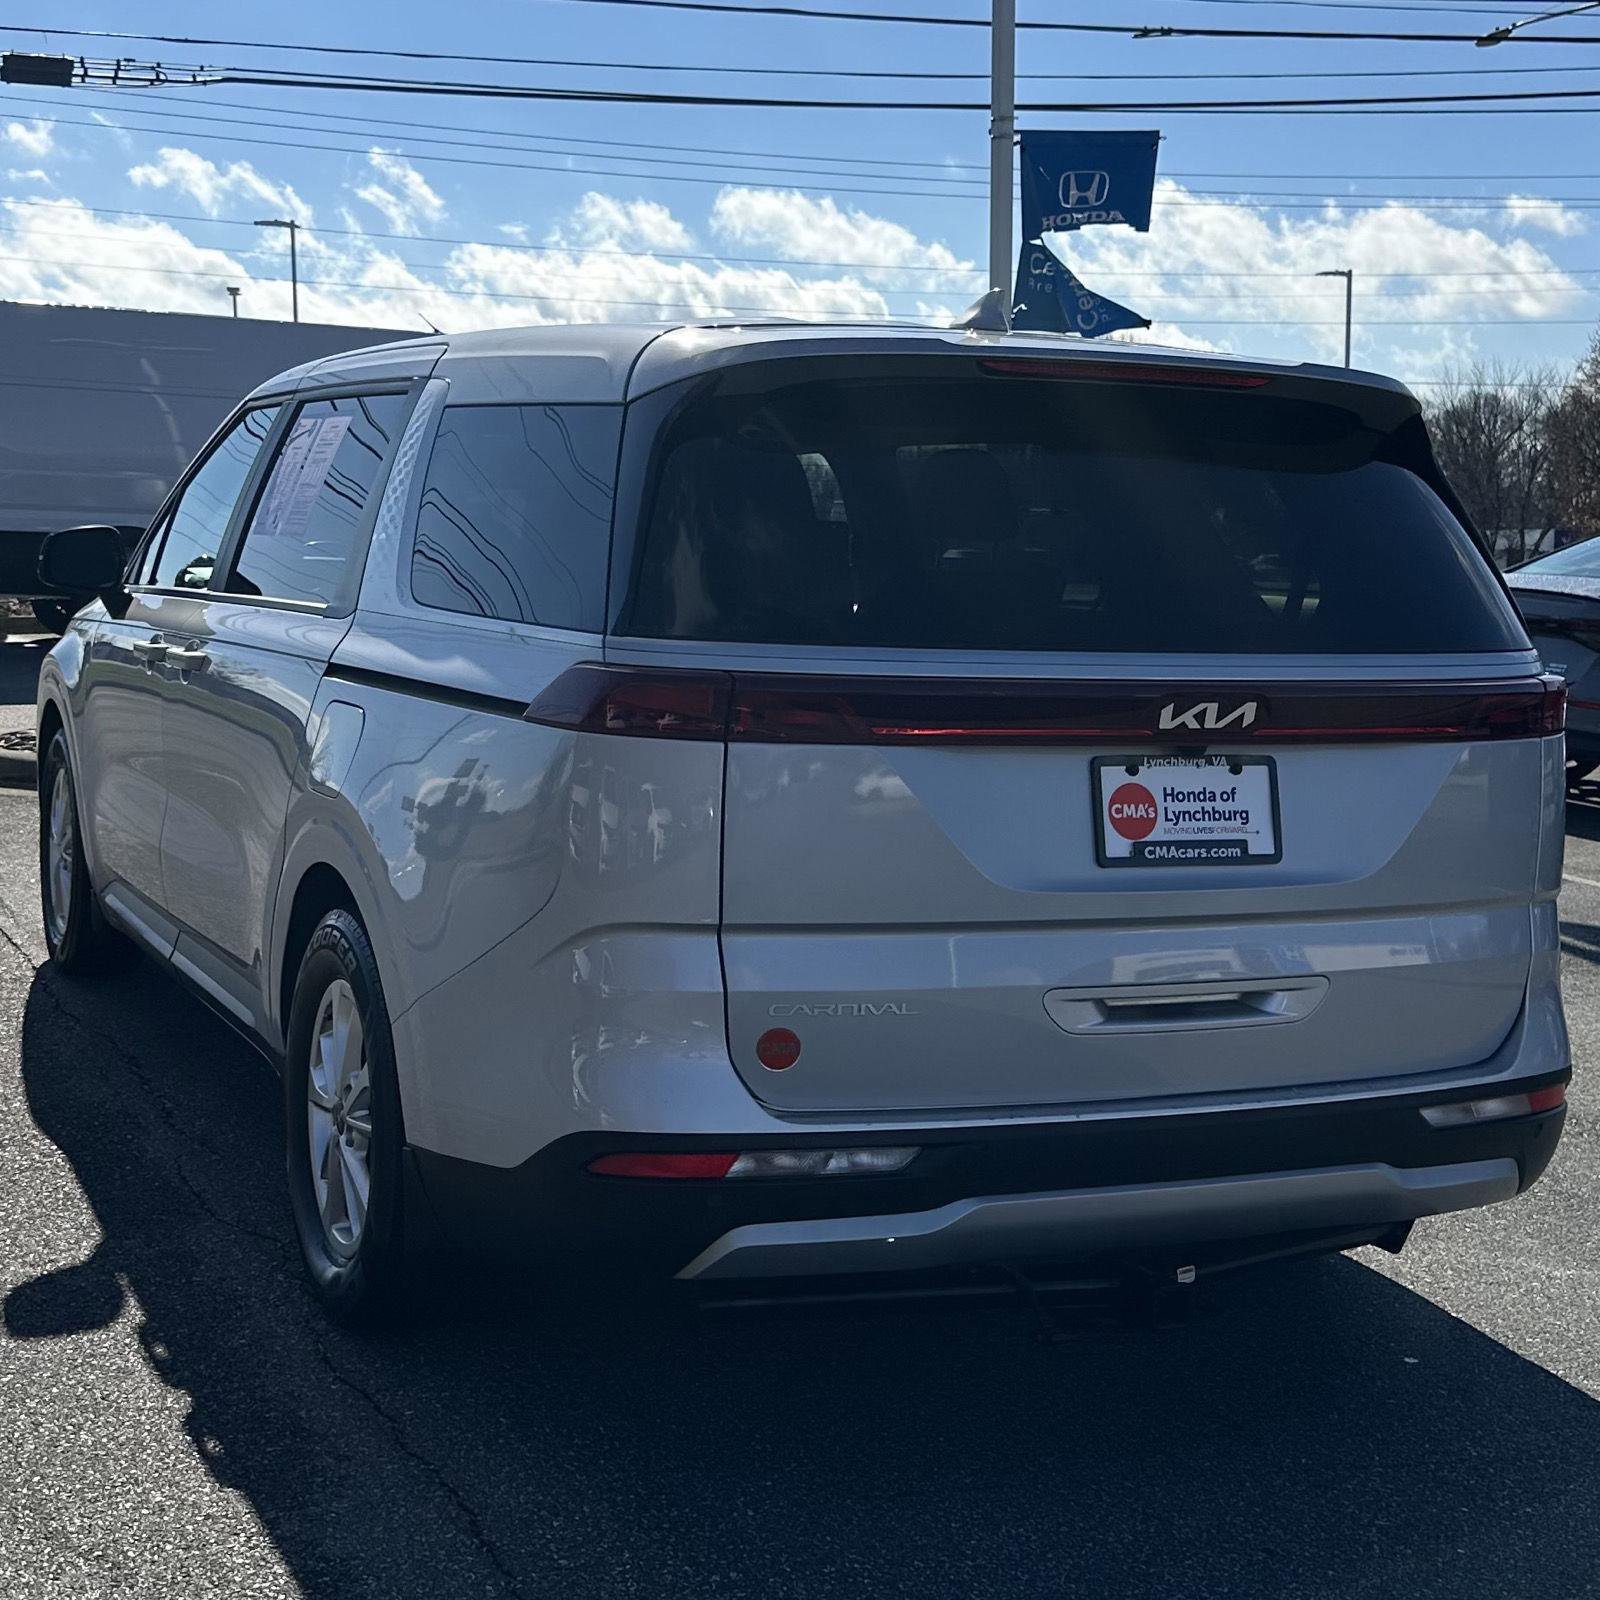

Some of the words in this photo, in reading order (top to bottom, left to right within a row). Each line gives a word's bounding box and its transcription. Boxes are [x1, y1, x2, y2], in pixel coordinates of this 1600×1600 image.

[1041, 210, 1126, 230] HONDA
[1159, 702, 1257, 729] KIA
[1143, 756, 1210, 769] Lynchburg,
[1211, 756, 1228, 767] VA
[1162, 786, 1217, 803] Honda
[1219, 786, 1237, 803] of
[1111, 803, 1156, 819] CMA's
[1163, 806, 1250, 826] Lynchburg
[1144, 846, 1241, 859] CMAcars.com
[768, 1002, 921, 1017] CARNIVAL
